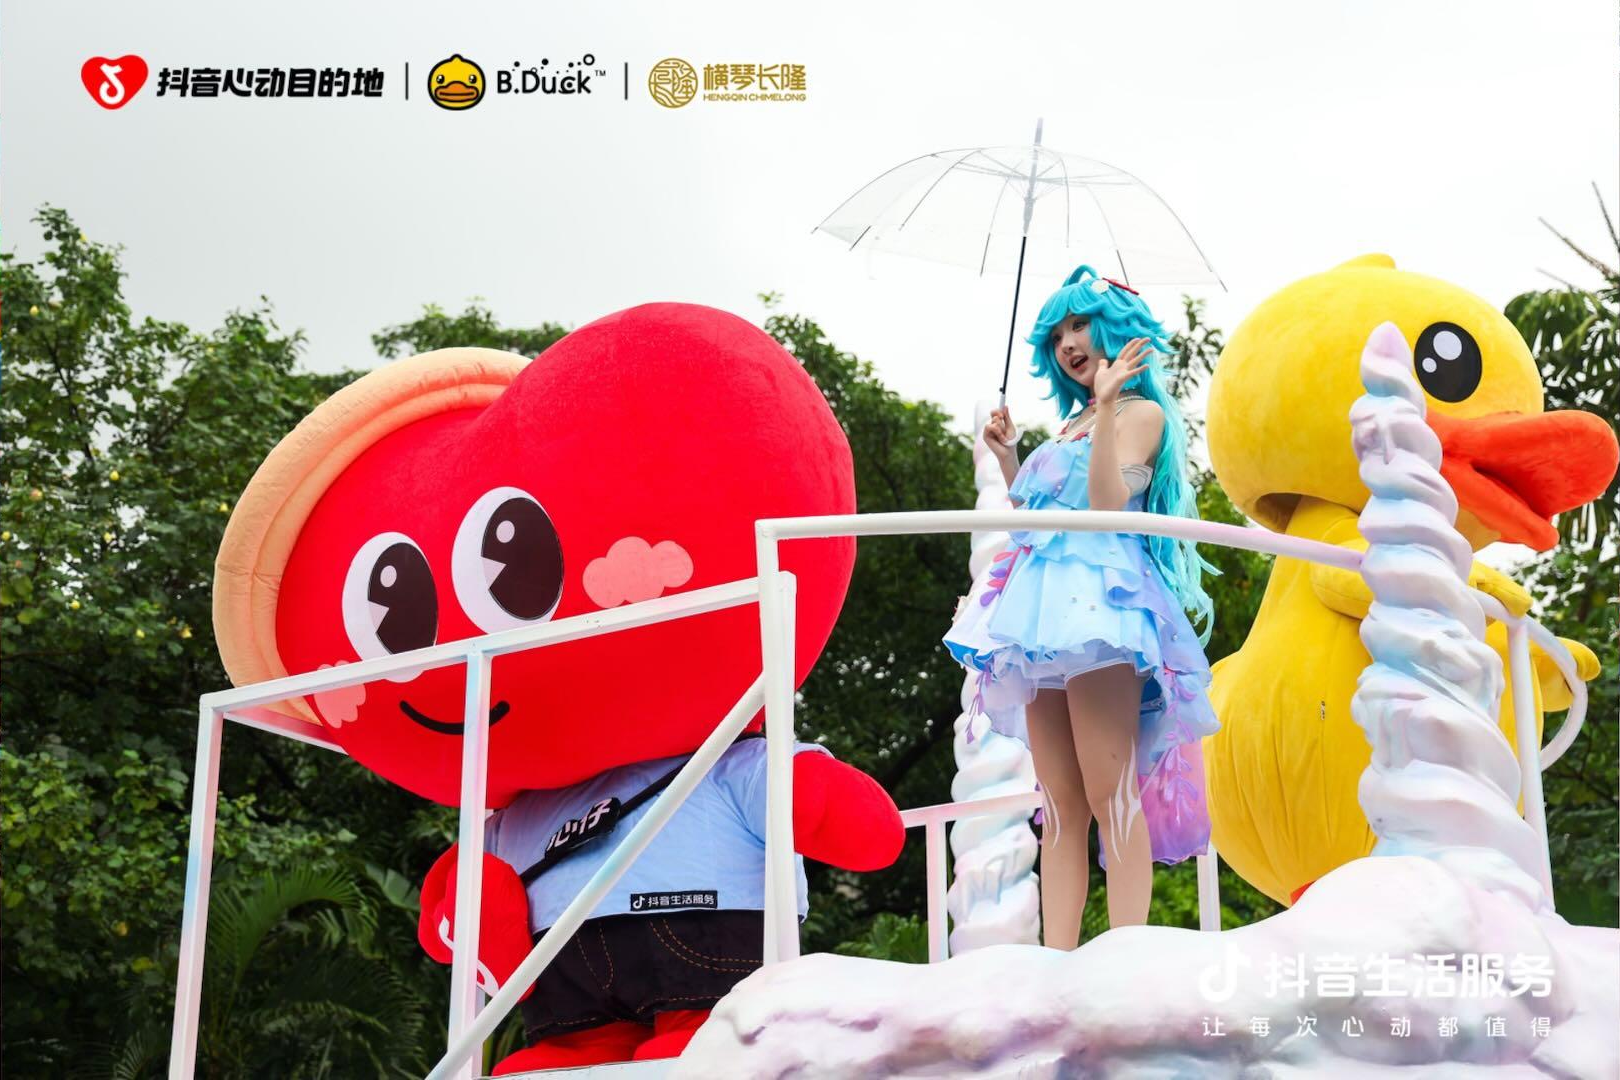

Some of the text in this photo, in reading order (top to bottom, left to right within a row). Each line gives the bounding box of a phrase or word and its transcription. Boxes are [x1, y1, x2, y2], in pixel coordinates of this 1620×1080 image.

[547, 798, 613, 851] 心仔
[648, 894, 715, 907] 抖音生活服务
